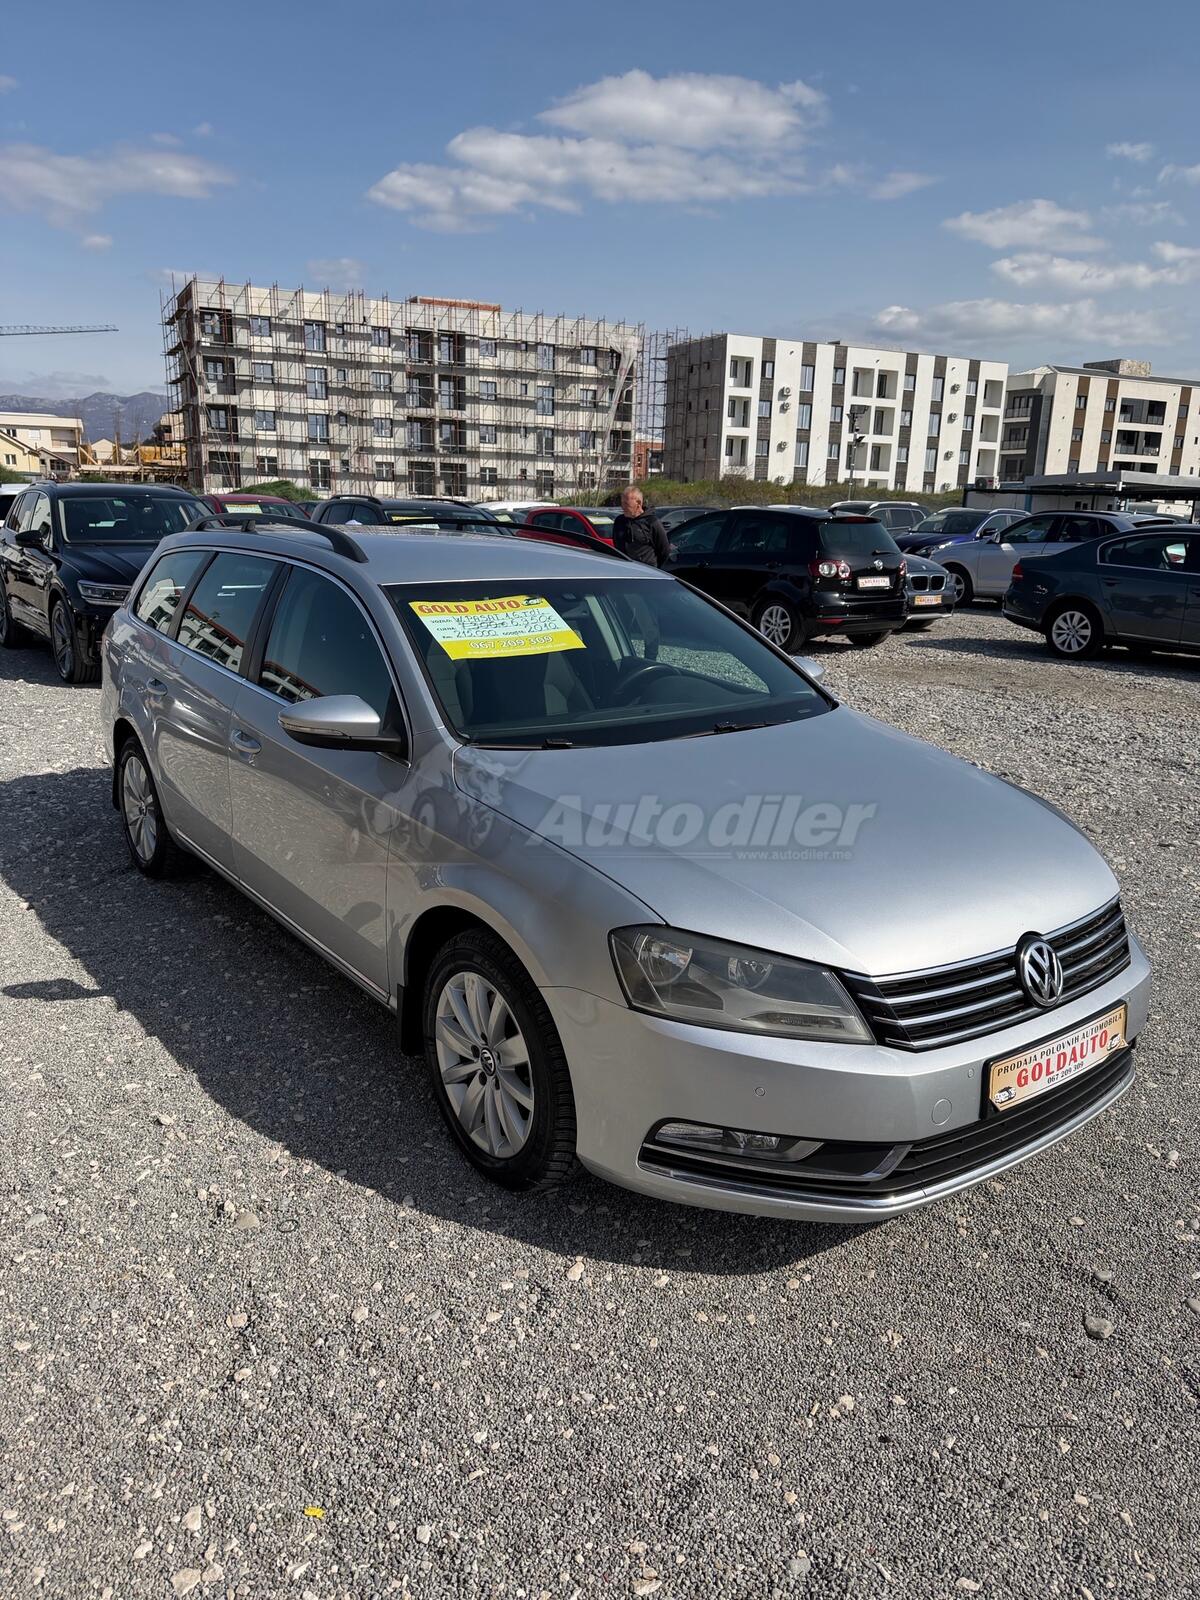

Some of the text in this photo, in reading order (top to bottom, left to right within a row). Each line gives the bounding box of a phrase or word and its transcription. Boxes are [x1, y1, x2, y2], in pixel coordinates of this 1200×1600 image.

[417, 600, 521, 614] GOLD AUTO
[469, 641, 496, 649] 067
[499, 639, 526, 648] 209
[528, 635, 554, 645] 309
[997, 1013, 1122, 1076] PRODAJA POLOVNIH AUTOMOBILA
[1016, 1029, 1108, 1088] GOLDAUTO
[1047, 1061, 1084, 1084] 067 209 309
